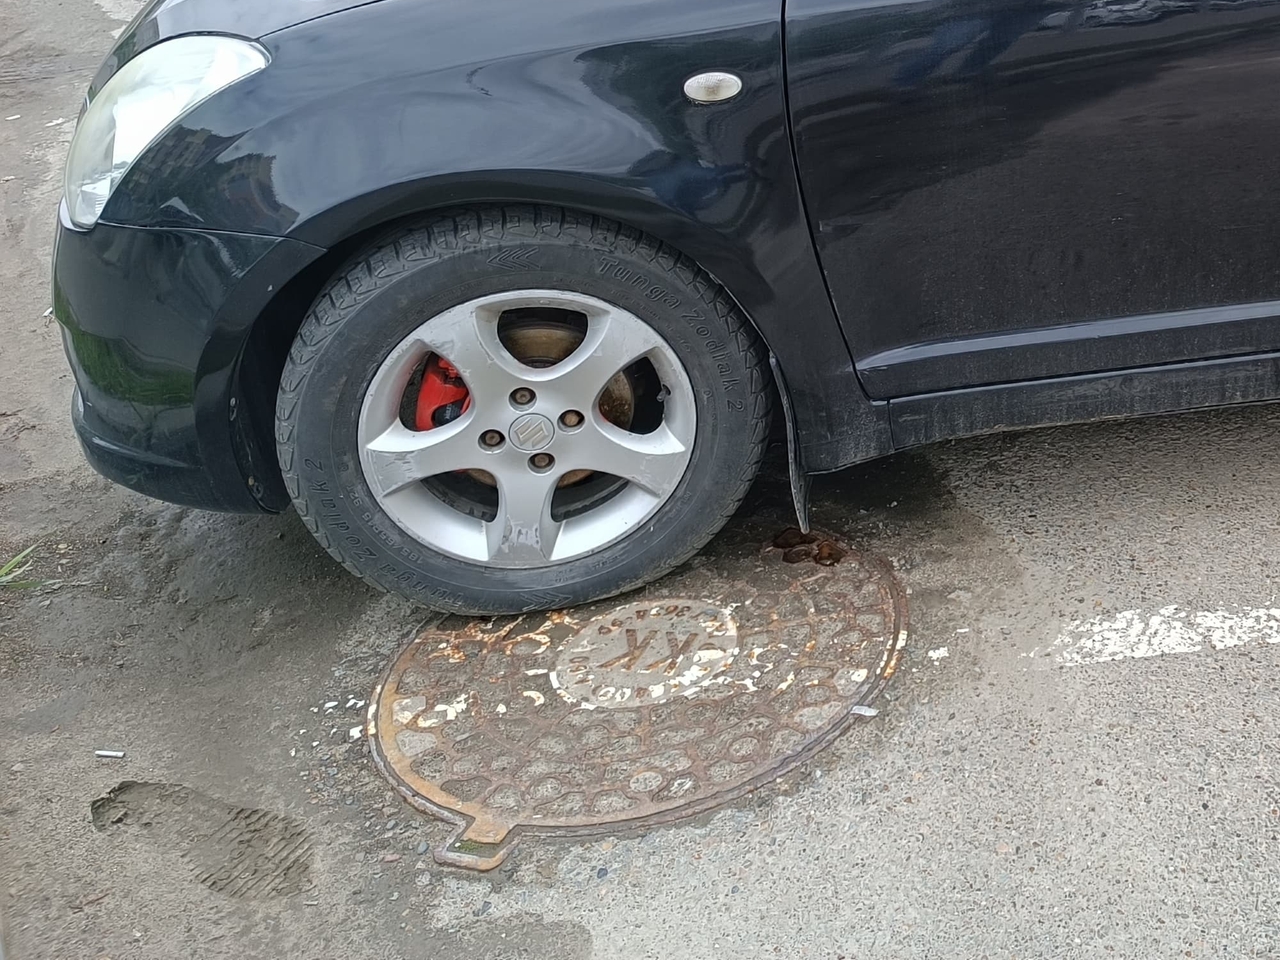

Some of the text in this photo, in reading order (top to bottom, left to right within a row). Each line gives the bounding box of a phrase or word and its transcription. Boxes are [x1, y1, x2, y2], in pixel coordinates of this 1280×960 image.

[600, 257, 681, 309] Tunga
[681, 307, 742, 391] Zodiak
[727, 399, 744, 413] 2
[310, 480, 378, 562] Zodiak
